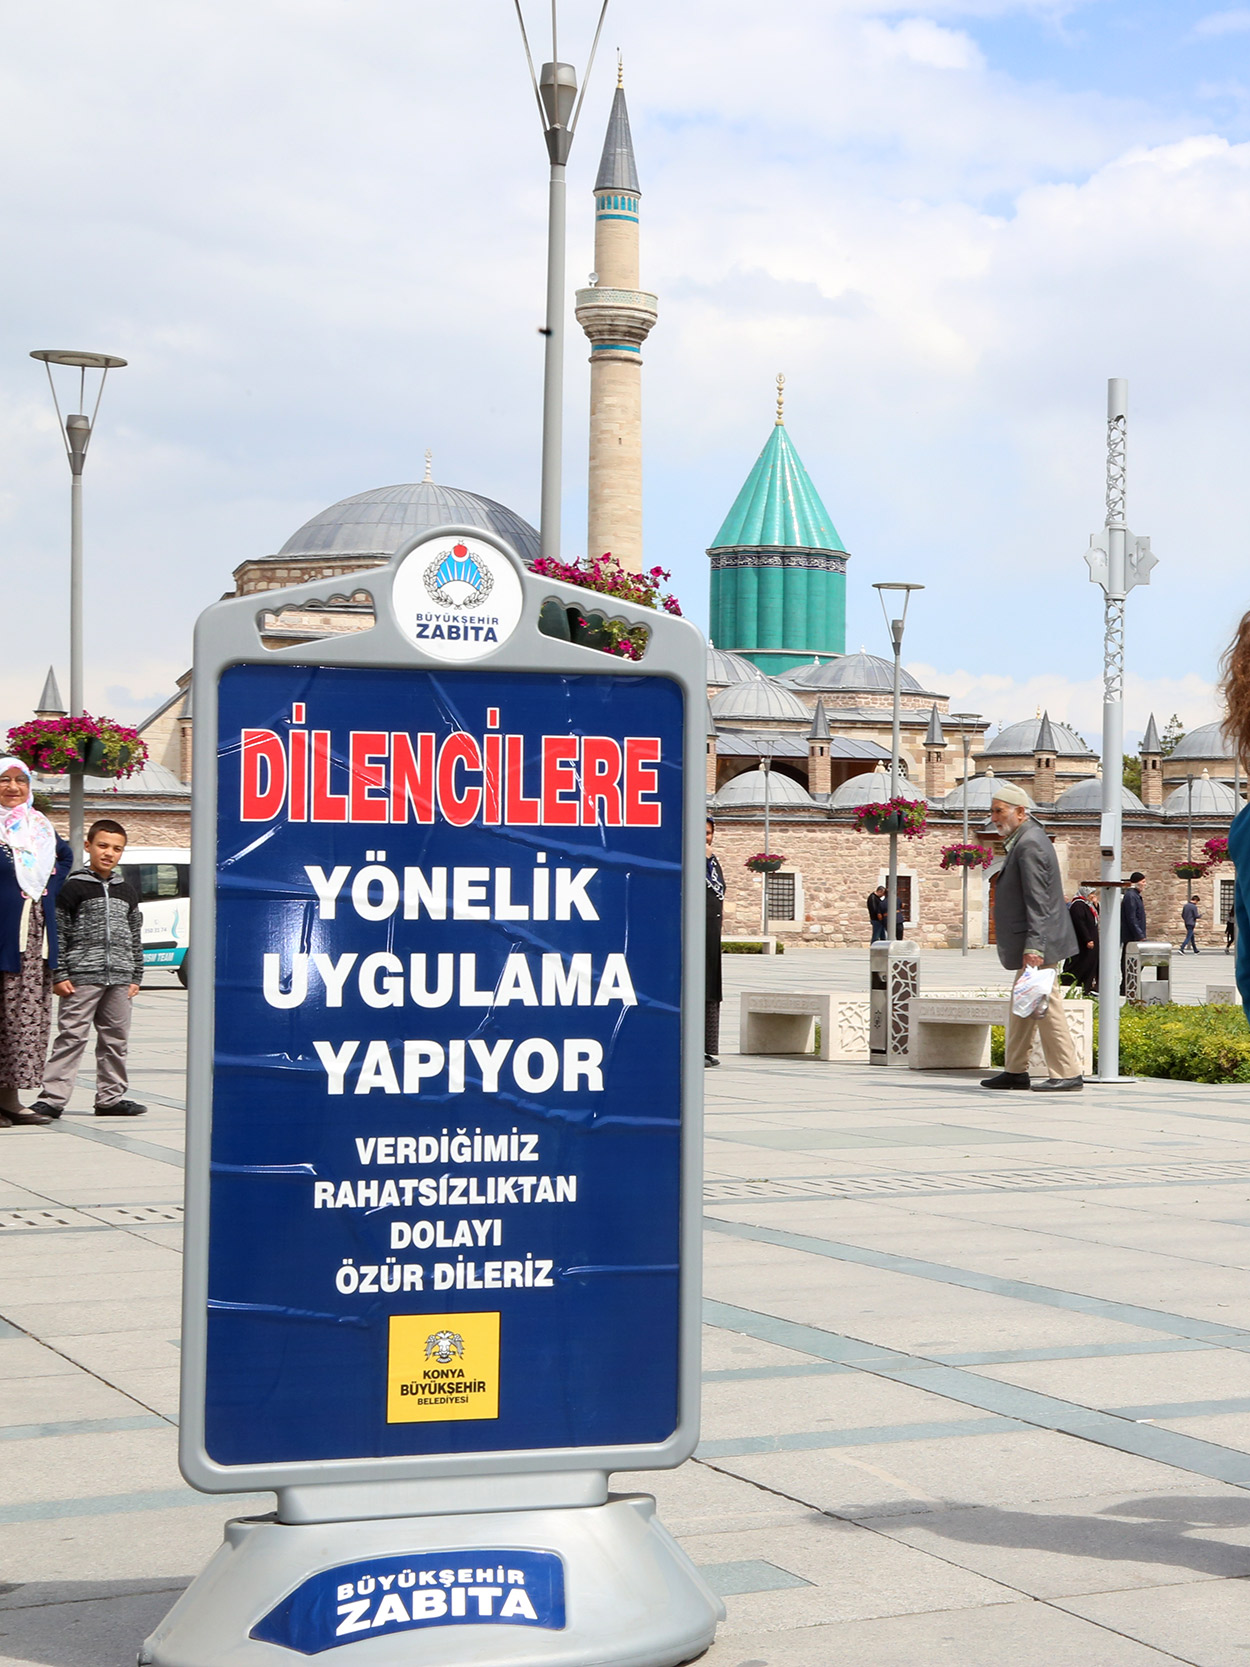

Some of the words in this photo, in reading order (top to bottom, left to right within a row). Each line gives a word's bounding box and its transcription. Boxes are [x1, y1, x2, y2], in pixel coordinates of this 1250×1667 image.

[416, 612, 499, 626] BÜYÜKŞEHİR
[240, 702, 661, 828] DİLENCİLERE
[303, 850, 600, 922] YÖNELİK
[262, 951, 637, 1009] UYGULAMA
[312, 1037, 604, 1096] YAPIYOR
[355, 1127, 539, 1165] VERDİĞİMİZ
[313, 1175, 577, 1209] RAHATSIZLIKTAN
[390, 1219, 502, 1250] DOLAYI
[335, 1257, 424, 1295] ÖZÜR
[433, 1252, 554, 1291] DİLERİZ
[400, 1378, 486, 1396] BÜYÜKŞEHİR
[423, 1368, 465, 1380] KONYA
[417, 1394, 469, 1405] BELEDİYESİ
[336, 1565, 525, 1602] BÜYÜKŞEHİR
[336, 1586, 539, 1637] ZABITA
